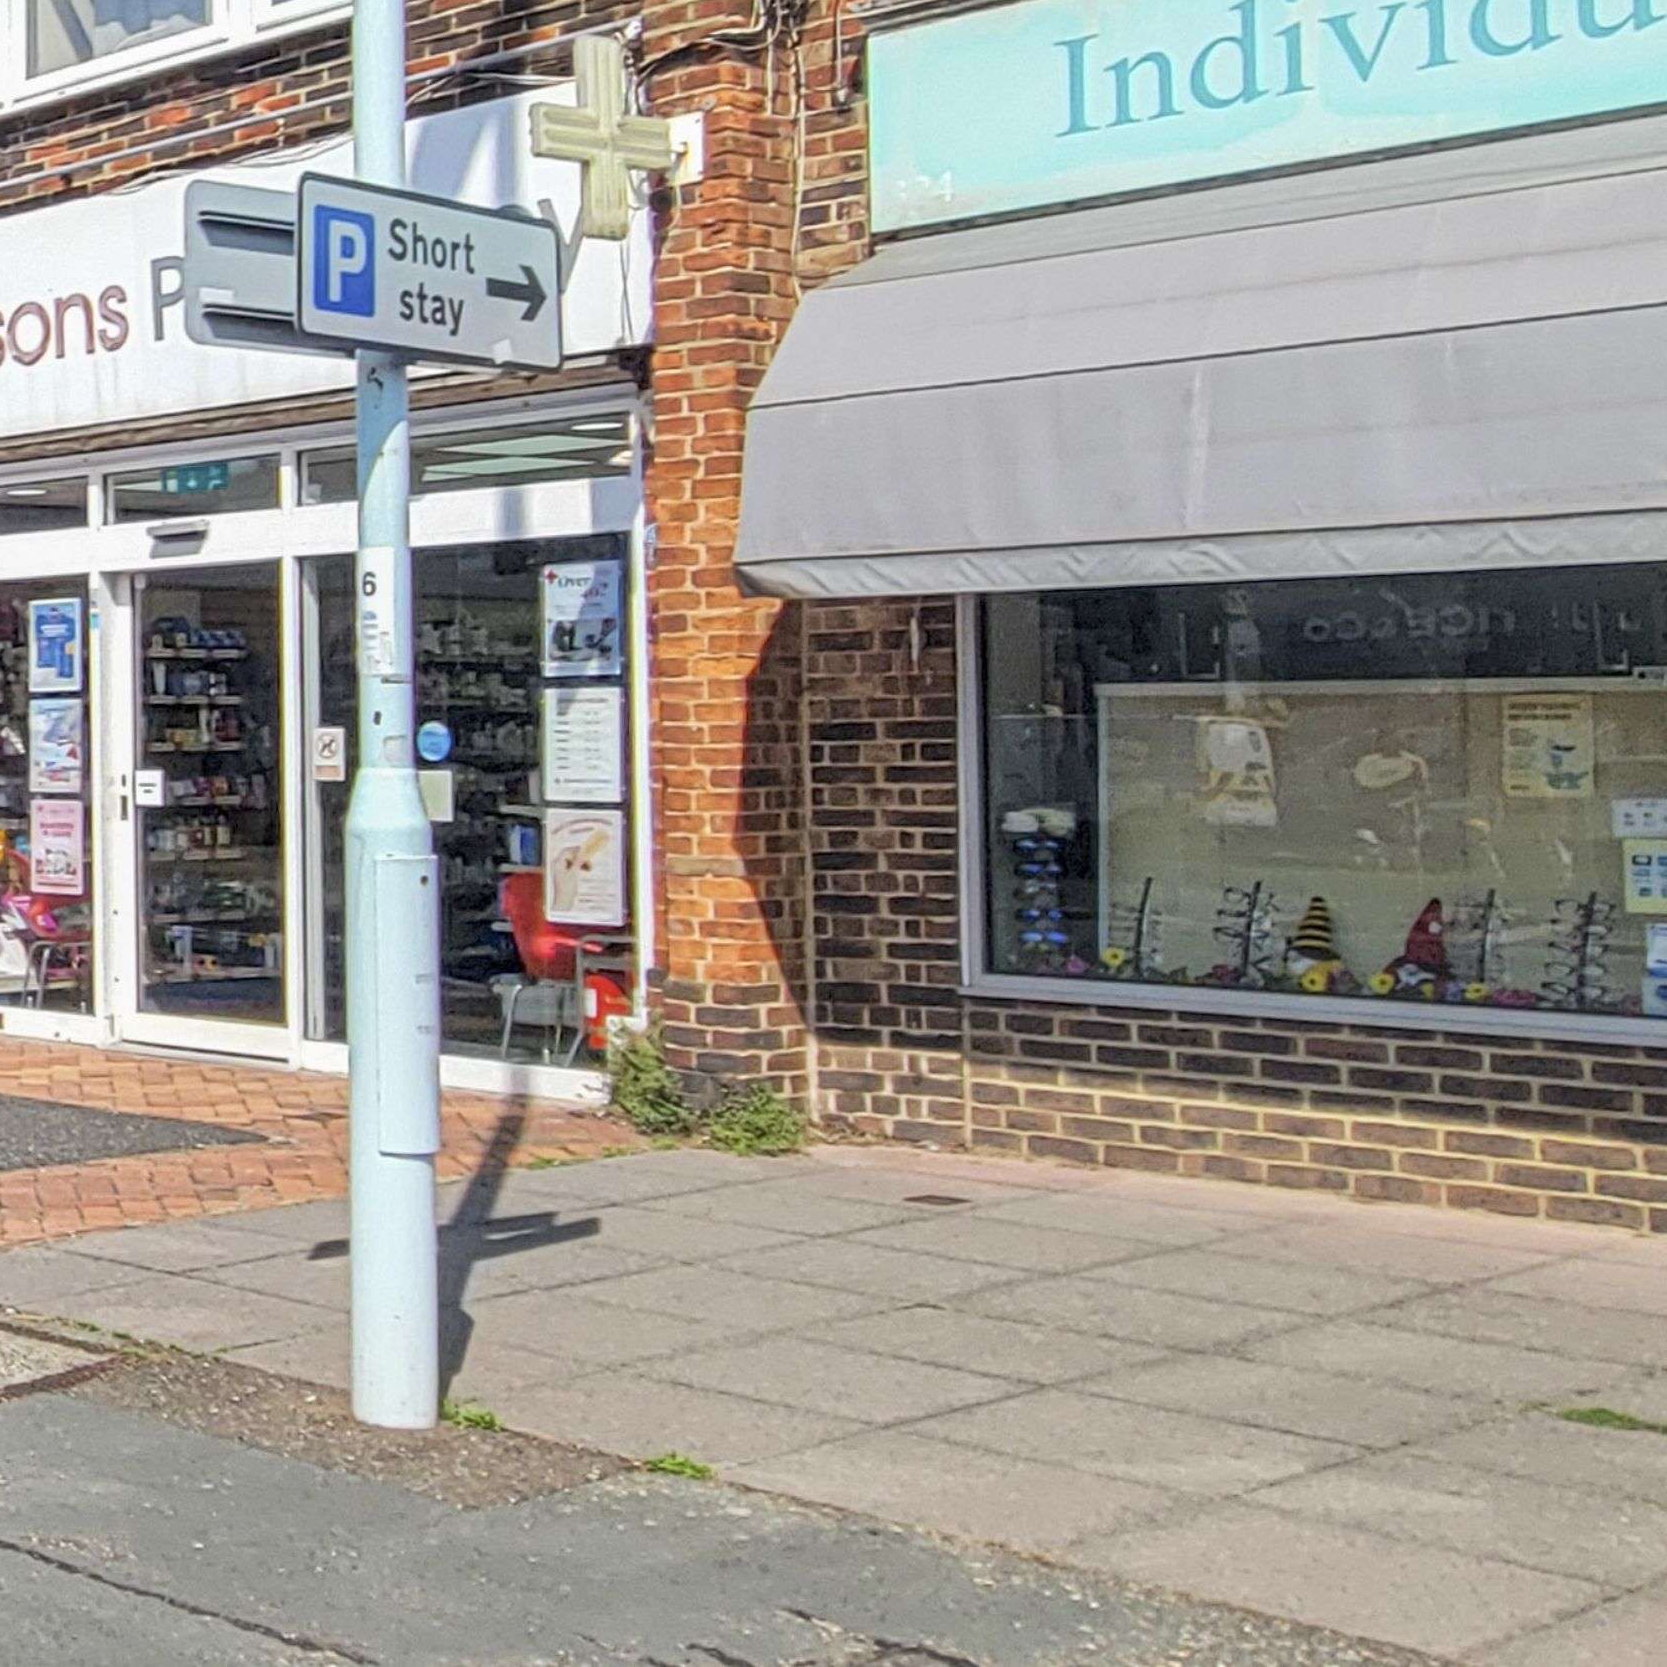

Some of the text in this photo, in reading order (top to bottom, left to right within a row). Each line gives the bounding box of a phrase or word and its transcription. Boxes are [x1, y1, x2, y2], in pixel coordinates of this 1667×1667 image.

[328, 219, 367, 303] P
[387, 217, 476, 275] Short
[400, 282, 465, 336] stay
